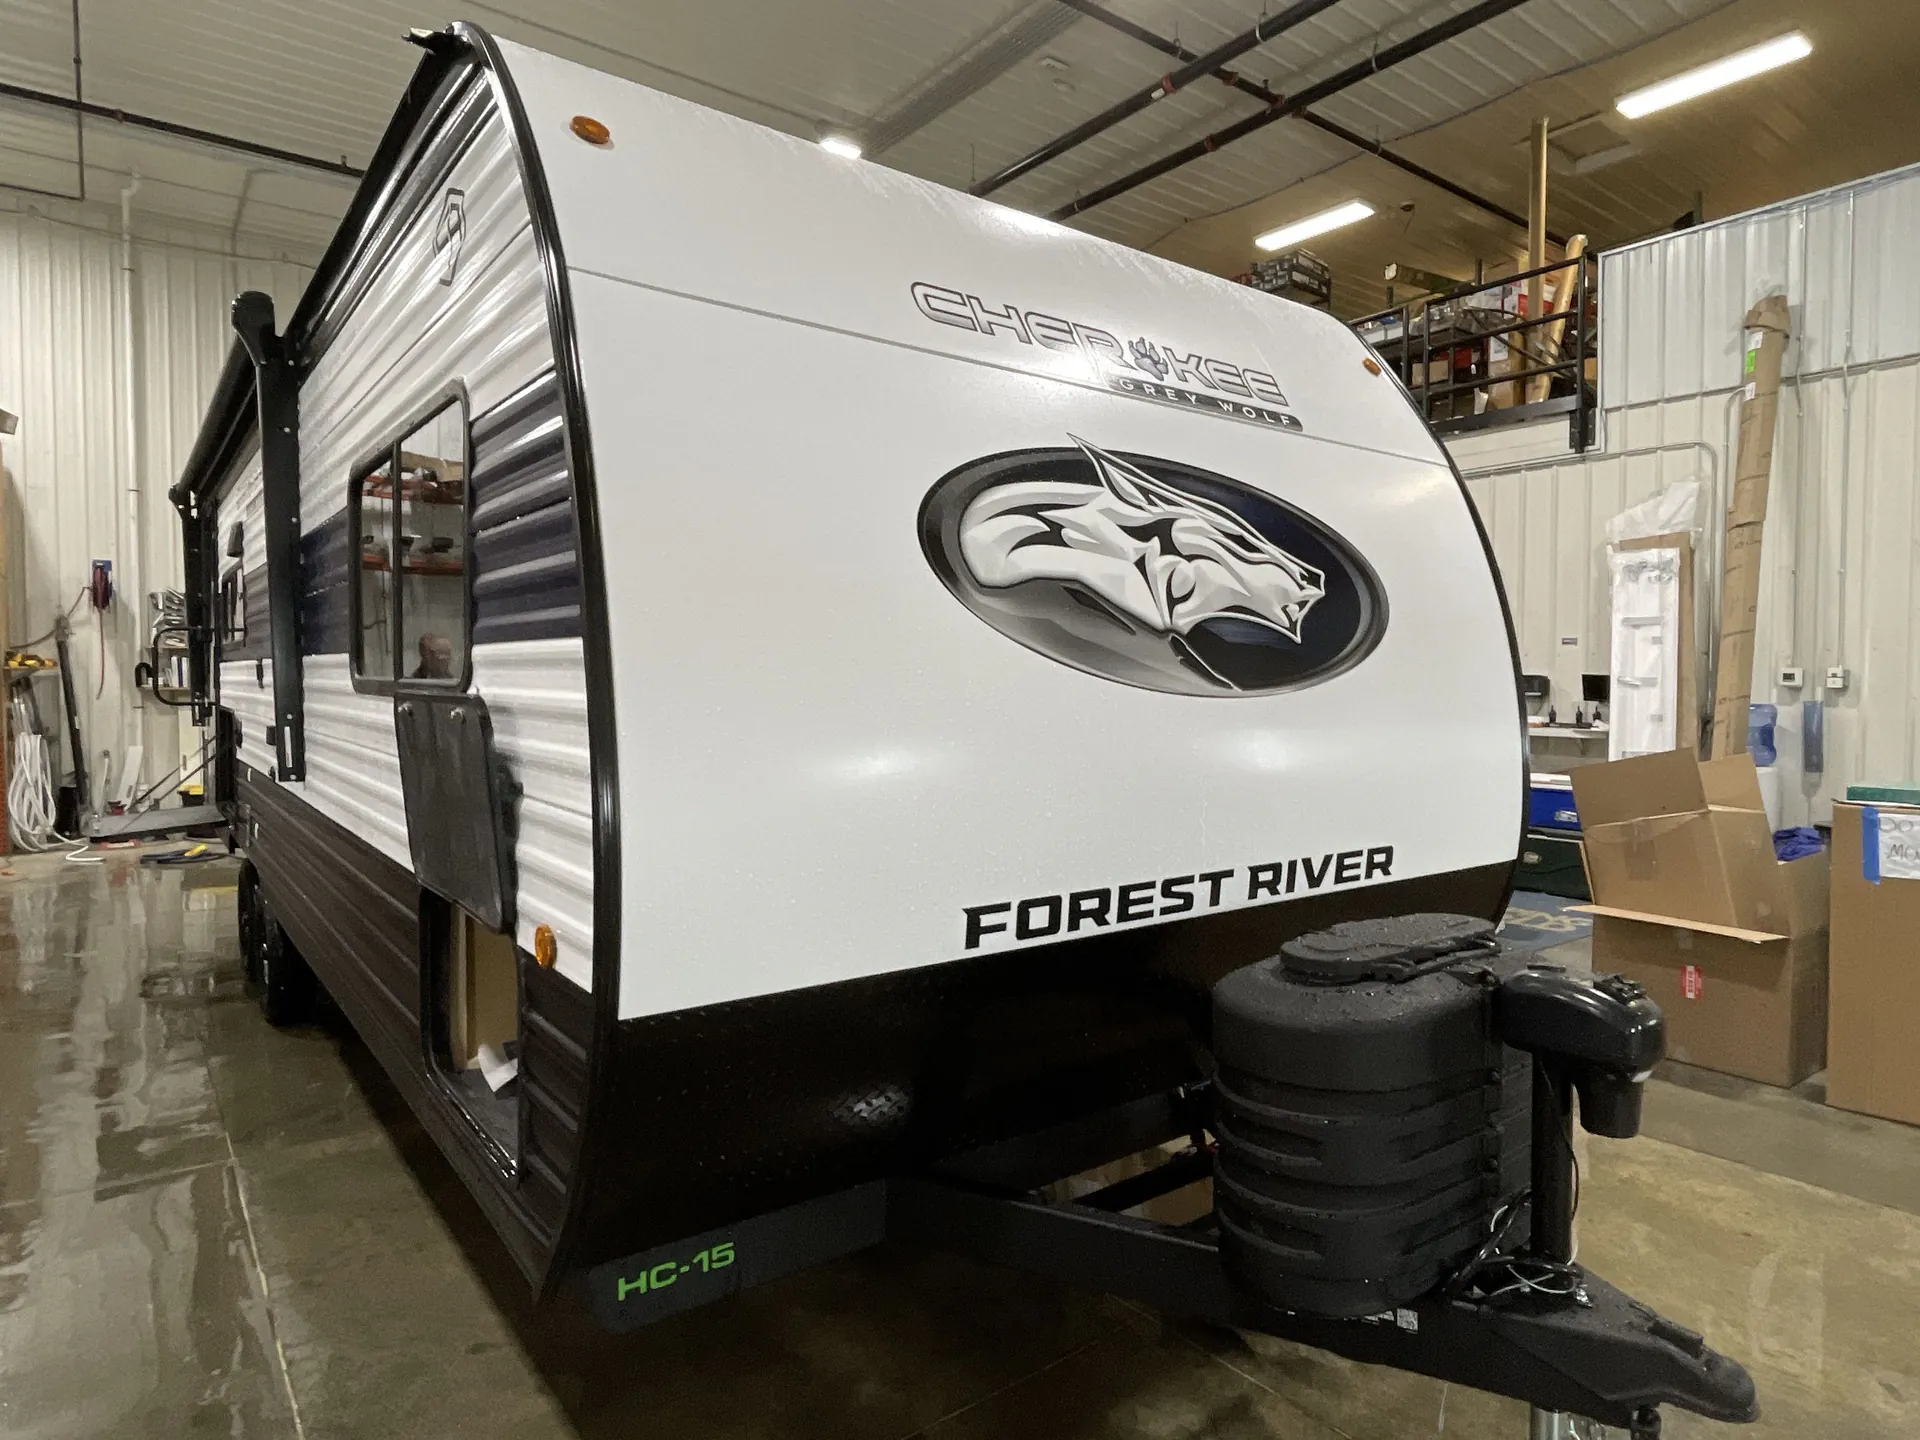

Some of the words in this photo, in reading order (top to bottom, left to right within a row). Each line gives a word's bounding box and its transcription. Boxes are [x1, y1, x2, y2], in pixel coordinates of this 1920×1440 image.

[1119, 379, 1199, 406] GREY
[1218, 400, 1292, 427] WOLF
[962, 868, 1235, 950] FOREST
[1247, 845, 1394, 900] RIVER
[618, 1242, 735, 1301] HC-15
